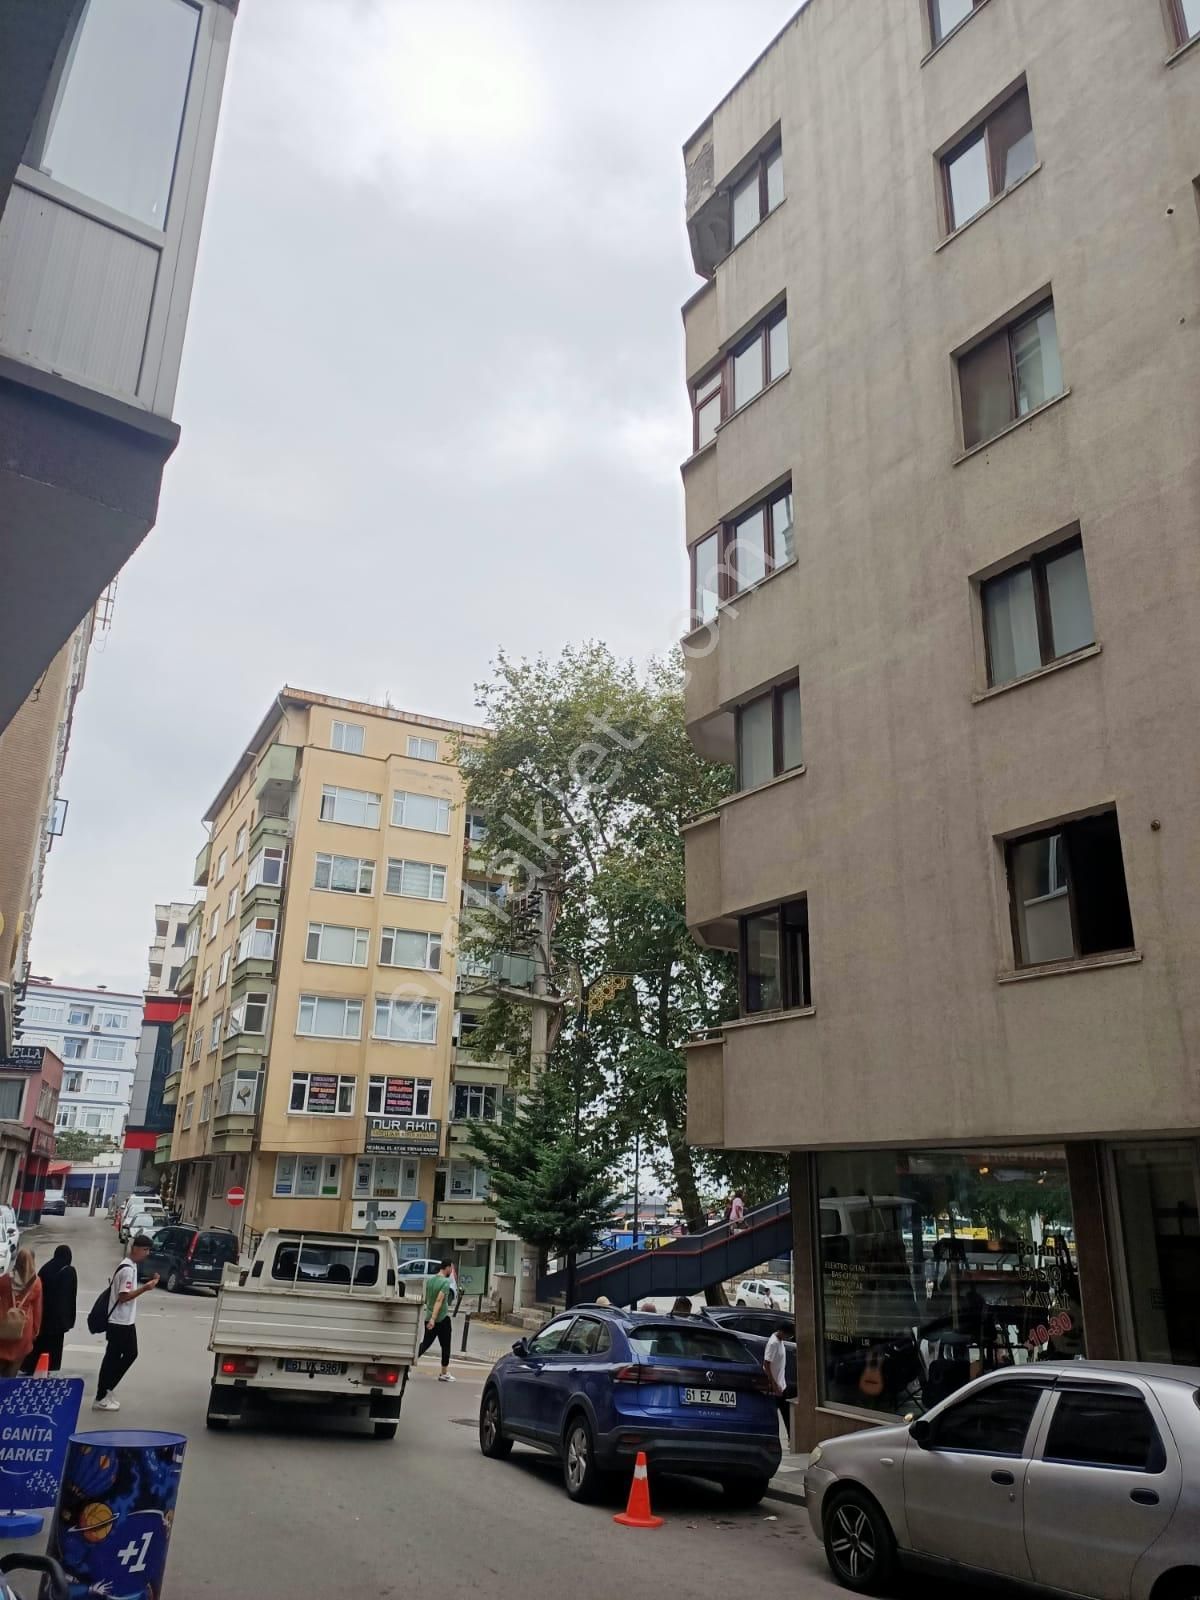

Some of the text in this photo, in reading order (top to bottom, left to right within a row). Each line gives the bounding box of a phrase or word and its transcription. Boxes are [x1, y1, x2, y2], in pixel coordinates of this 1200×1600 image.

[372, 1119, 437, 1132] NUR AKIN
[1018, 1240, 1063, 1257] Roland
[1018, 1265, 1062, 1282] CASIO
[686, 1389, 735, 1404] 61 EZ 404
[2, 1424, 53, 1442] GANİTA
[118, 1531, 154, 1573] +1
